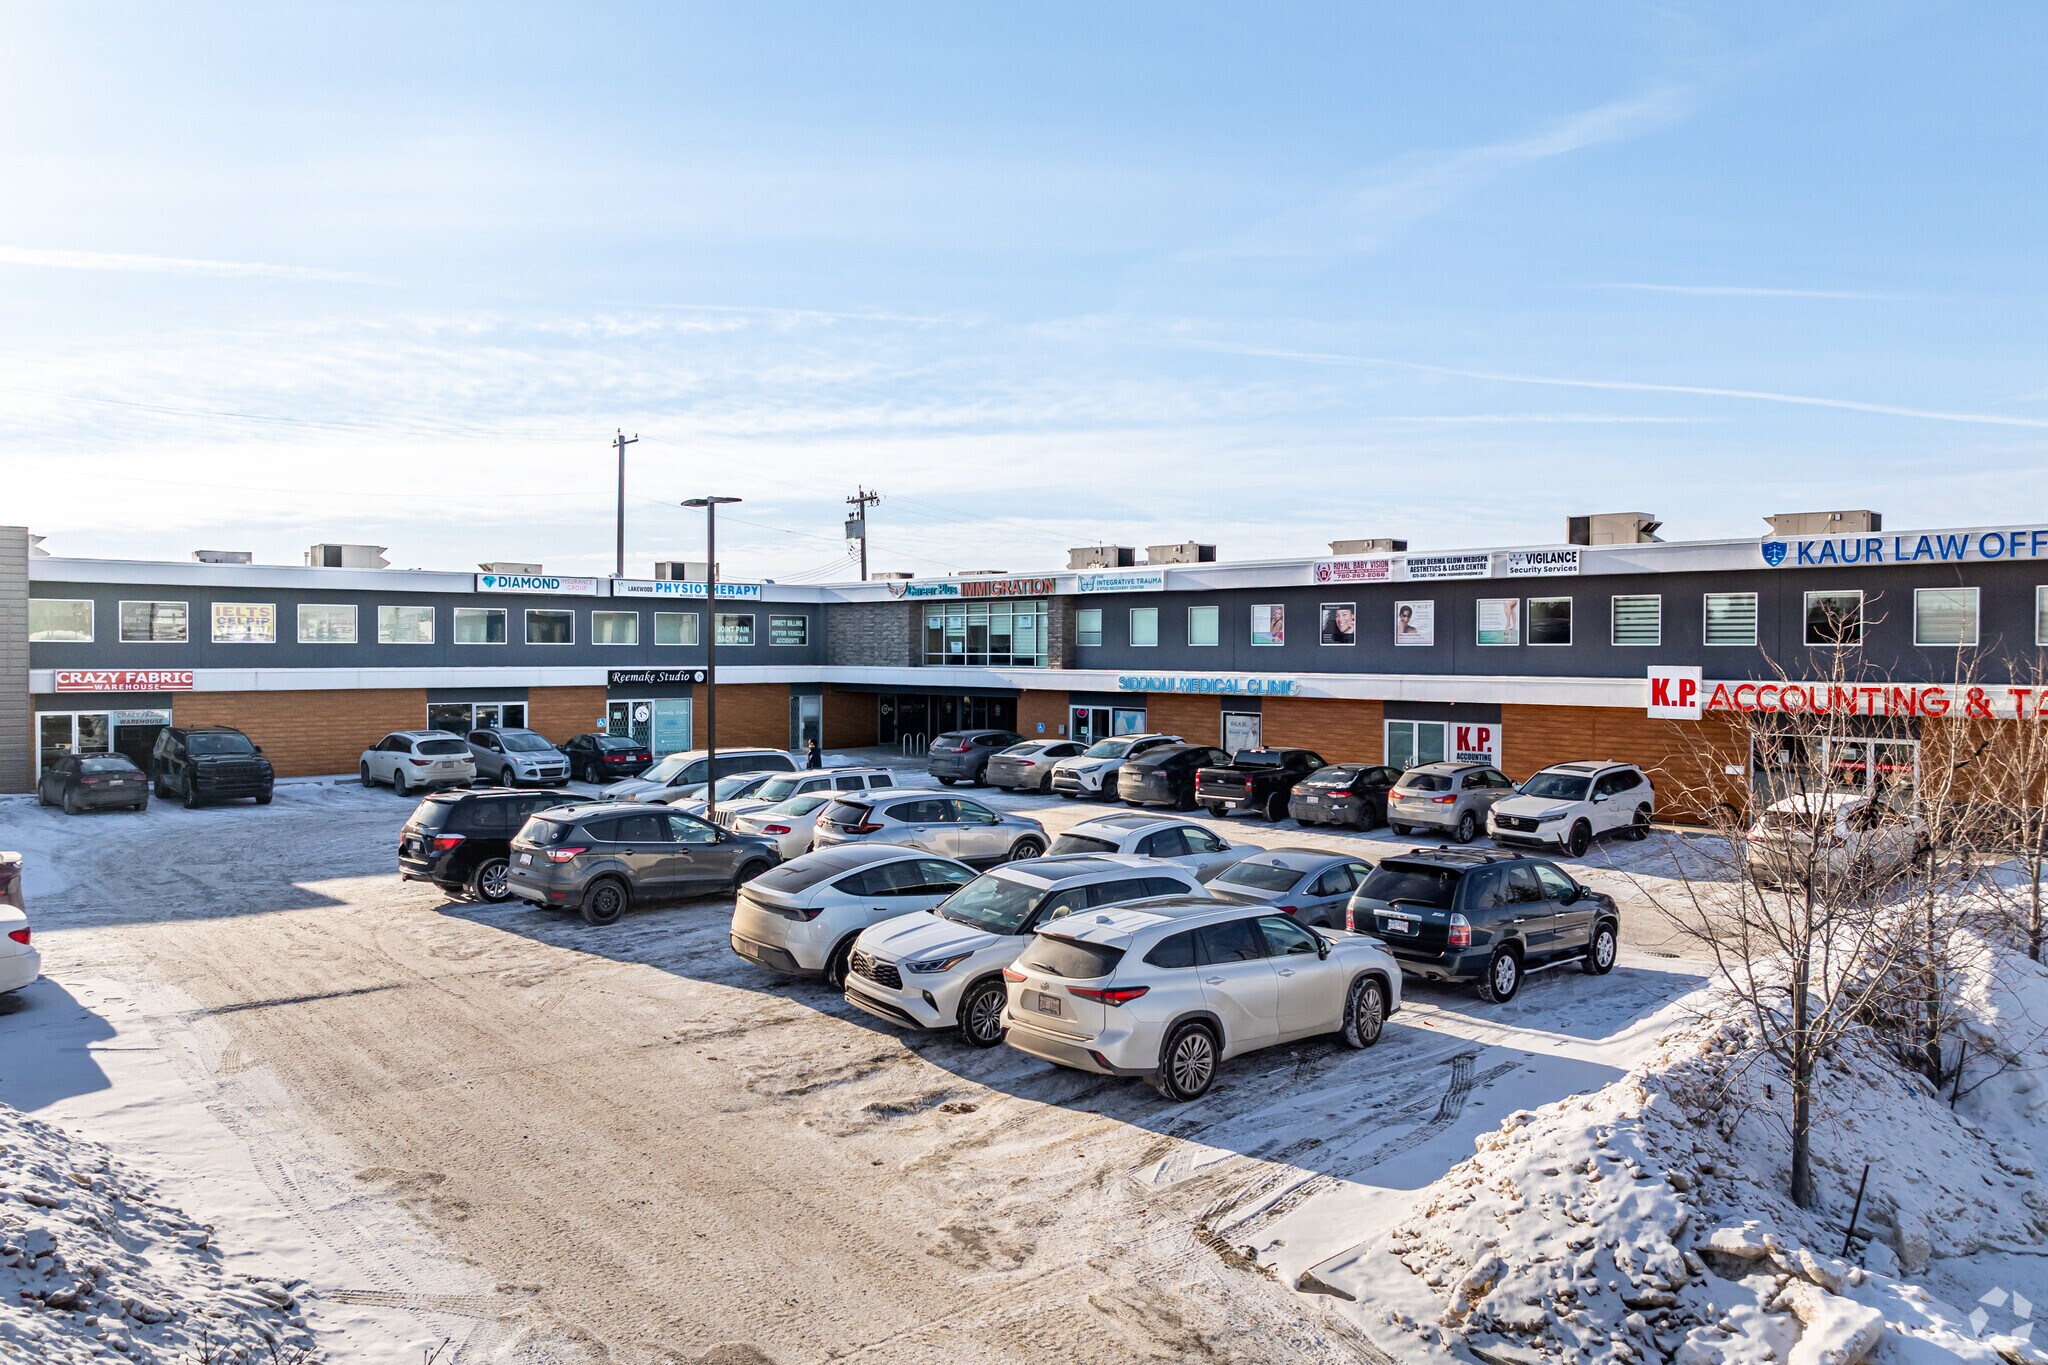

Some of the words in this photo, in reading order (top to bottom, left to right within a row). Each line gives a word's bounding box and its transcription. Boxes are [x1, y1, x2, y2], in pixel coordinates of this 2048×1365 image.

[1797, 537, 1884, 565] KAUR
[1894, 533, 1969, 561] LAW
[1526, 552, 1577, 565] VIGILANCE
[1334, 562, 1350, 570] ROYAL
[1353, 561, 1367, 569] BABY
[1370, 560, 1389, 568] VISION
[1410, 565, 1441, 573] AESTHETICS
[1510, 566, 1542, 574] Security
[1543, 565, 1577, 573] Services
[498, 576, 560, 590] DIAMOND
[908, 584, 937, 596] Career
[938, 583, 958, 595] Plus
[960, 578, 1056, 597] IMMIGRATION
[1096, 578, 1135, 586] INTEGRATIVE
[215, 606, 271, 617] IELTS
[771, 619, 786, 627] DIRECT
[735, 626, 750, 634] PAIN
[717, 635, 734, 643] BACK
[734, 635, 749, 643] PAIN
[57, 672, 120, 684] CRAZY
[125, 672, 193, 684] FABRIC
[612, 671, 655, 684] Reemake
[657, 670, 690, 682] Studio
[1118, 676, 1176, 691] SIDDIQUI
[1179, 677, 1243, 693] MEDICAL
[1247, 678, 1301, 696] CLINIC
[1652, 678, 1696, 707] K.P.
[1707, 683, 1951, 719] ACCOUNTING
[1965, 687, 1998, 719] &
[1456, 726, 1492, 752] K.P.
[1456, 752, 1492, 761] ACCOUNTING
